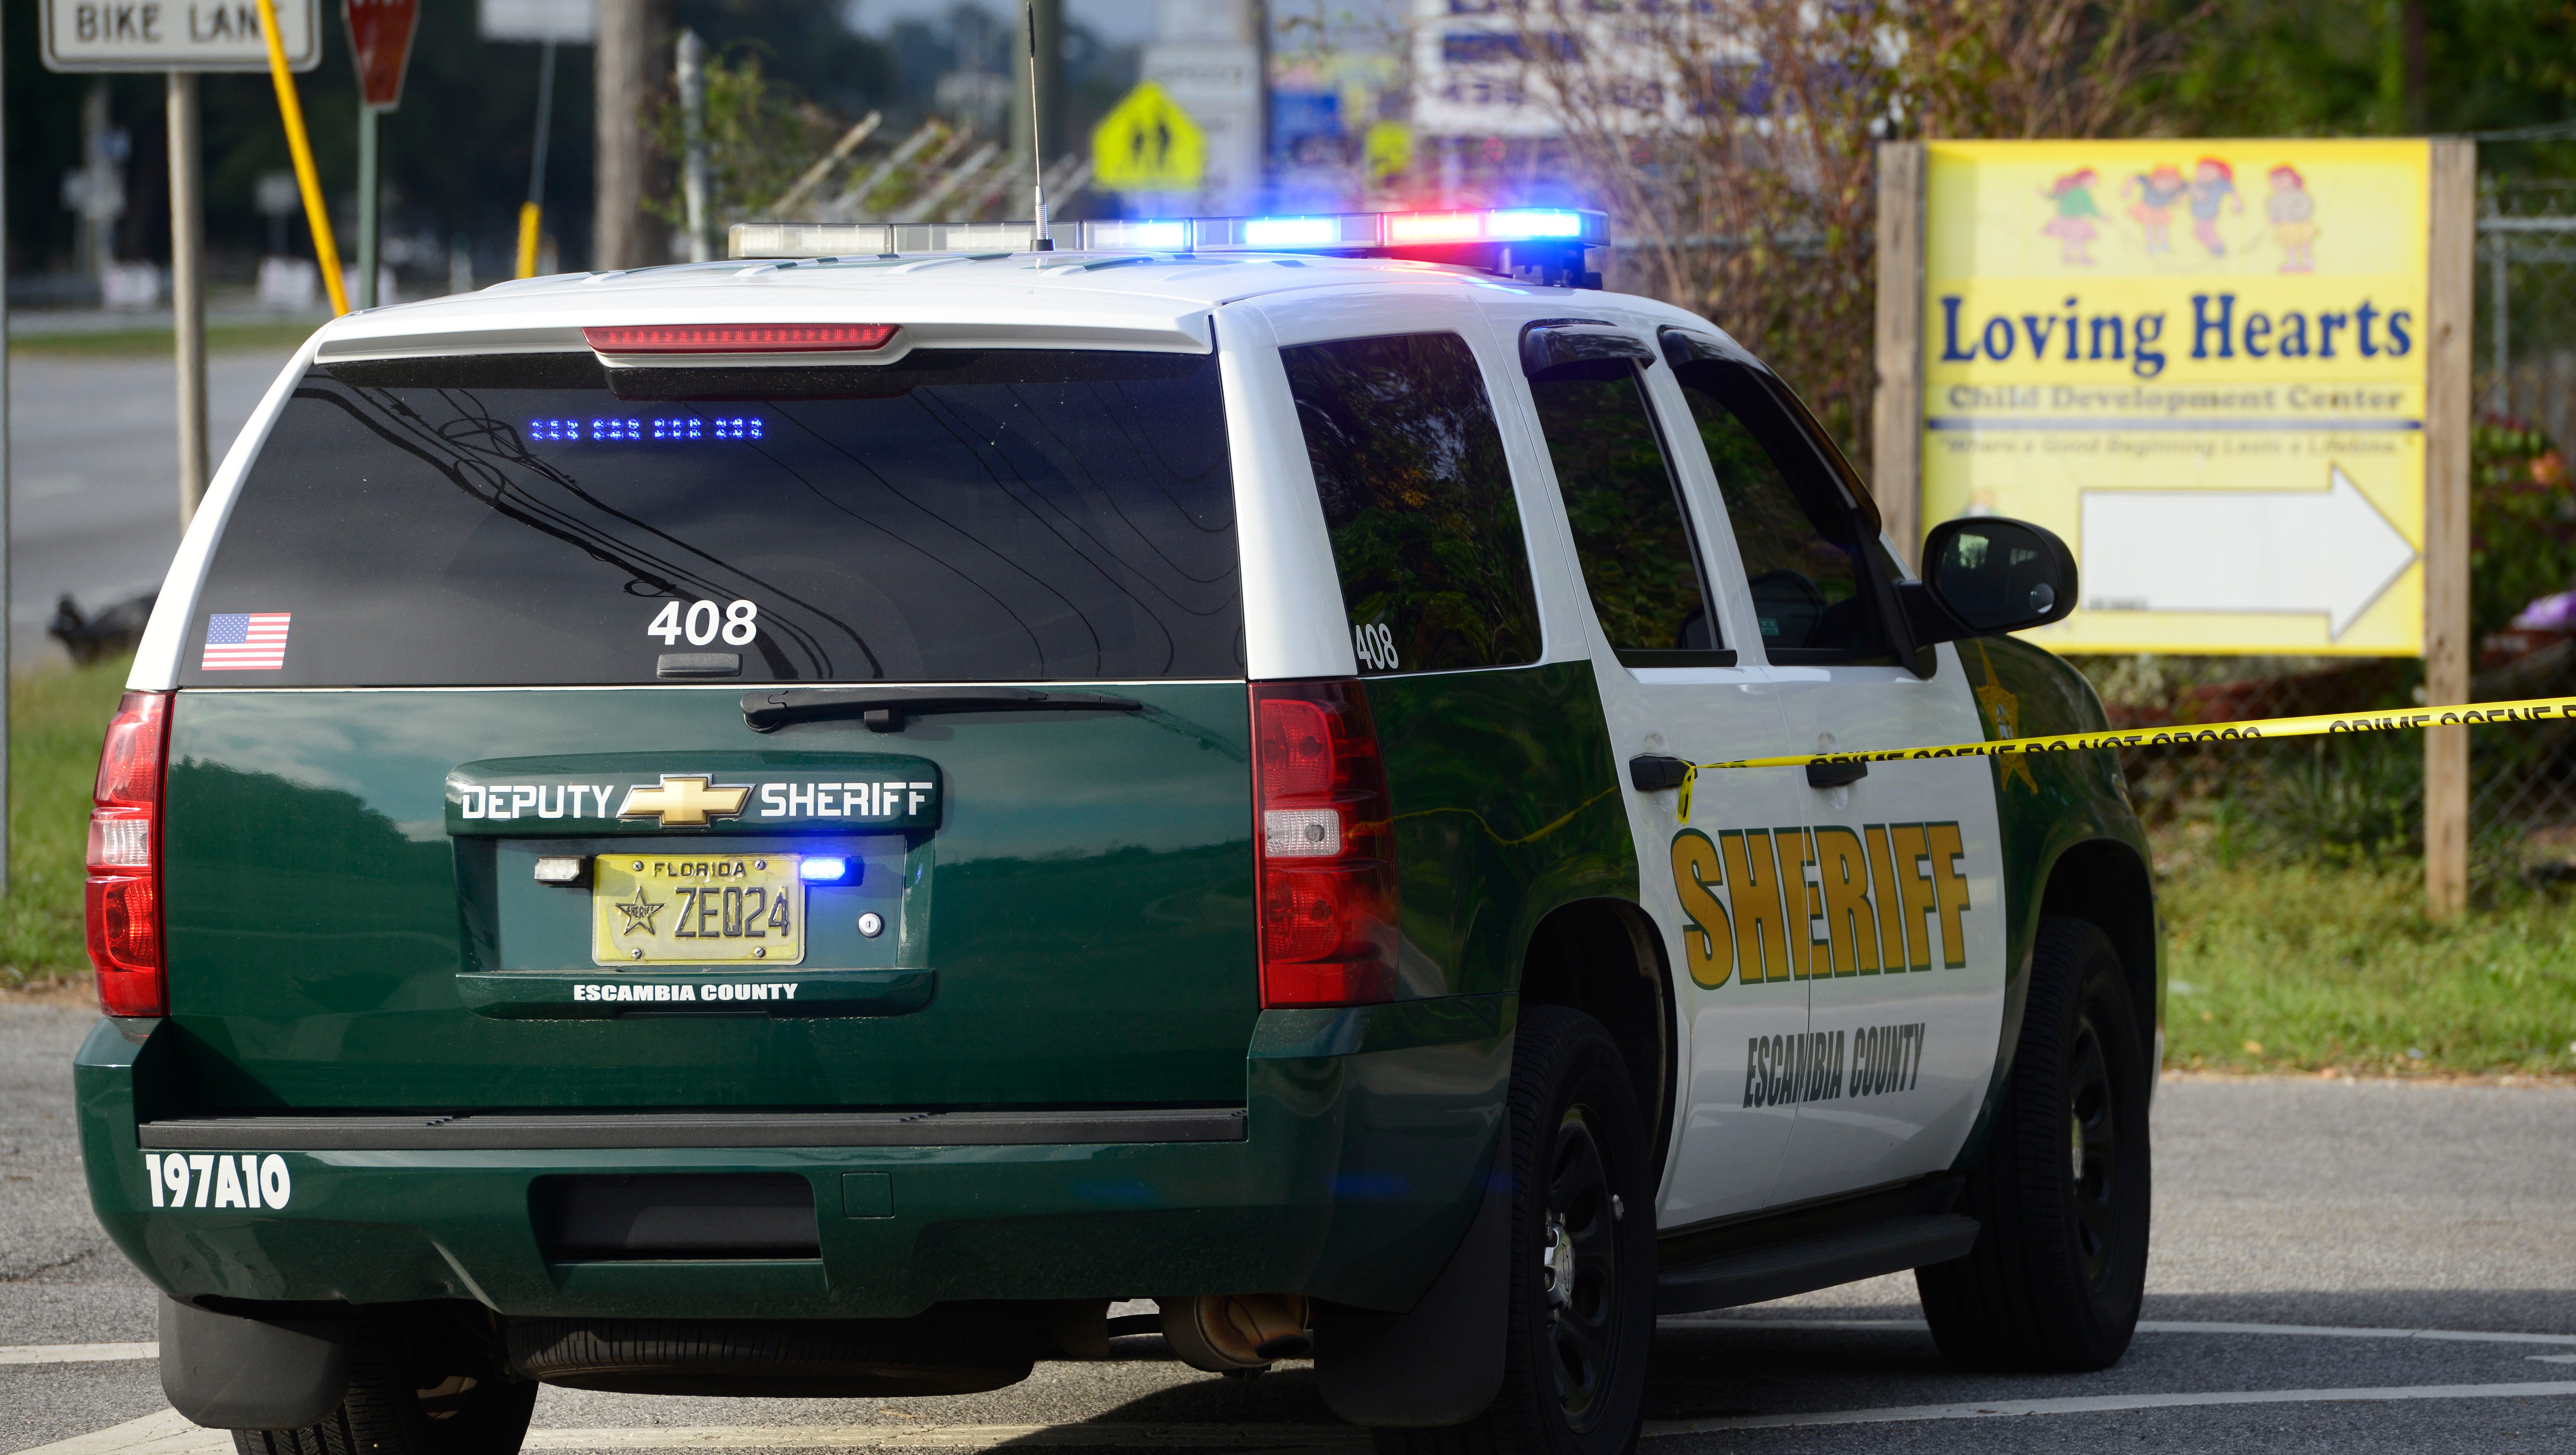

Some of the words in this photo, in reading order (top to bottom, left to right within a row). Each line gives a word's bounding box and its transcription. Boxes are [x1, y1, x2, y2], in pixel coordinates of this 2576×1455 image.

[77, 4, 160, 42] BIKE
[1941, 296, 2166, 377] Loving
[2192, 295, 2412, 357] Hearts
[1948, 385, 2039, 408] Child
[2052, 385, 2275, 415] Development
[2288, 385, 2404, 408] Center
[648, 600, 757, 645] 408
[1356, 623, 1398, 669] 408
[463, 785, 614, 818] DEPUTY
[761, 782, 932, 816] SHERIFF
[653, 862, 746, 877] FLORIDA
[1670, 821, 1971, 990] SHERIFF
[574, 985, 696, 1001] ESCAMBIA
[701, 983, 798, 1000] COUNTY
[1743, 1030, 1844, 1108] ESCAMBIA
[1849, 1023, 1925, 1097] COUNTY
[145, 1153, 291, 1210] 197A10
